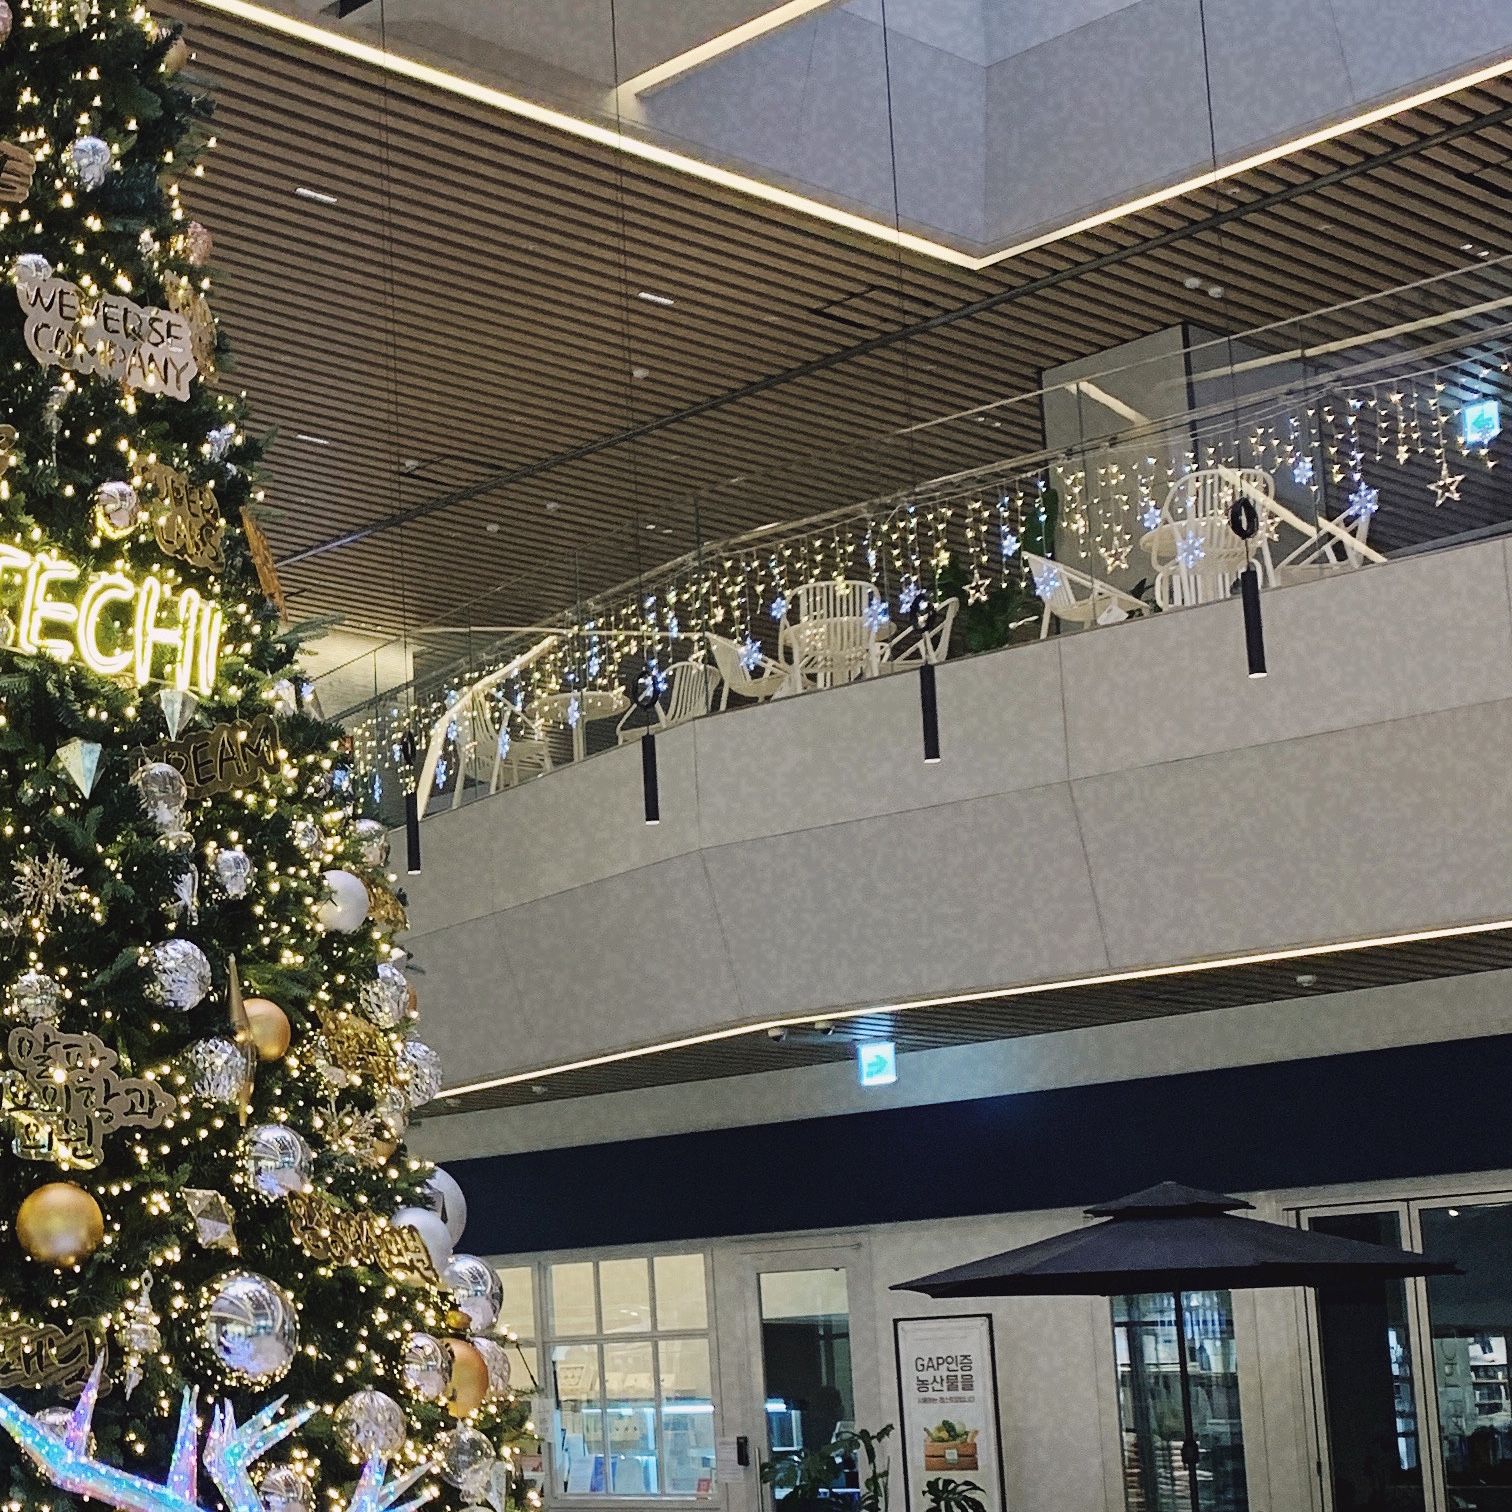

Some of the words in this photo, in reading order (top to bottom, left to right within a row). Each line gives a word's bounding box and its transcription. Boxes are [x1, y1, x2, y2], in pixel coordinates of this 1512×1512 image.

[25, 285, 184, 348] WEVERSE
[138, 725, 276, 789] REAM
[914, 1354, 973, 1373] GAP인증
